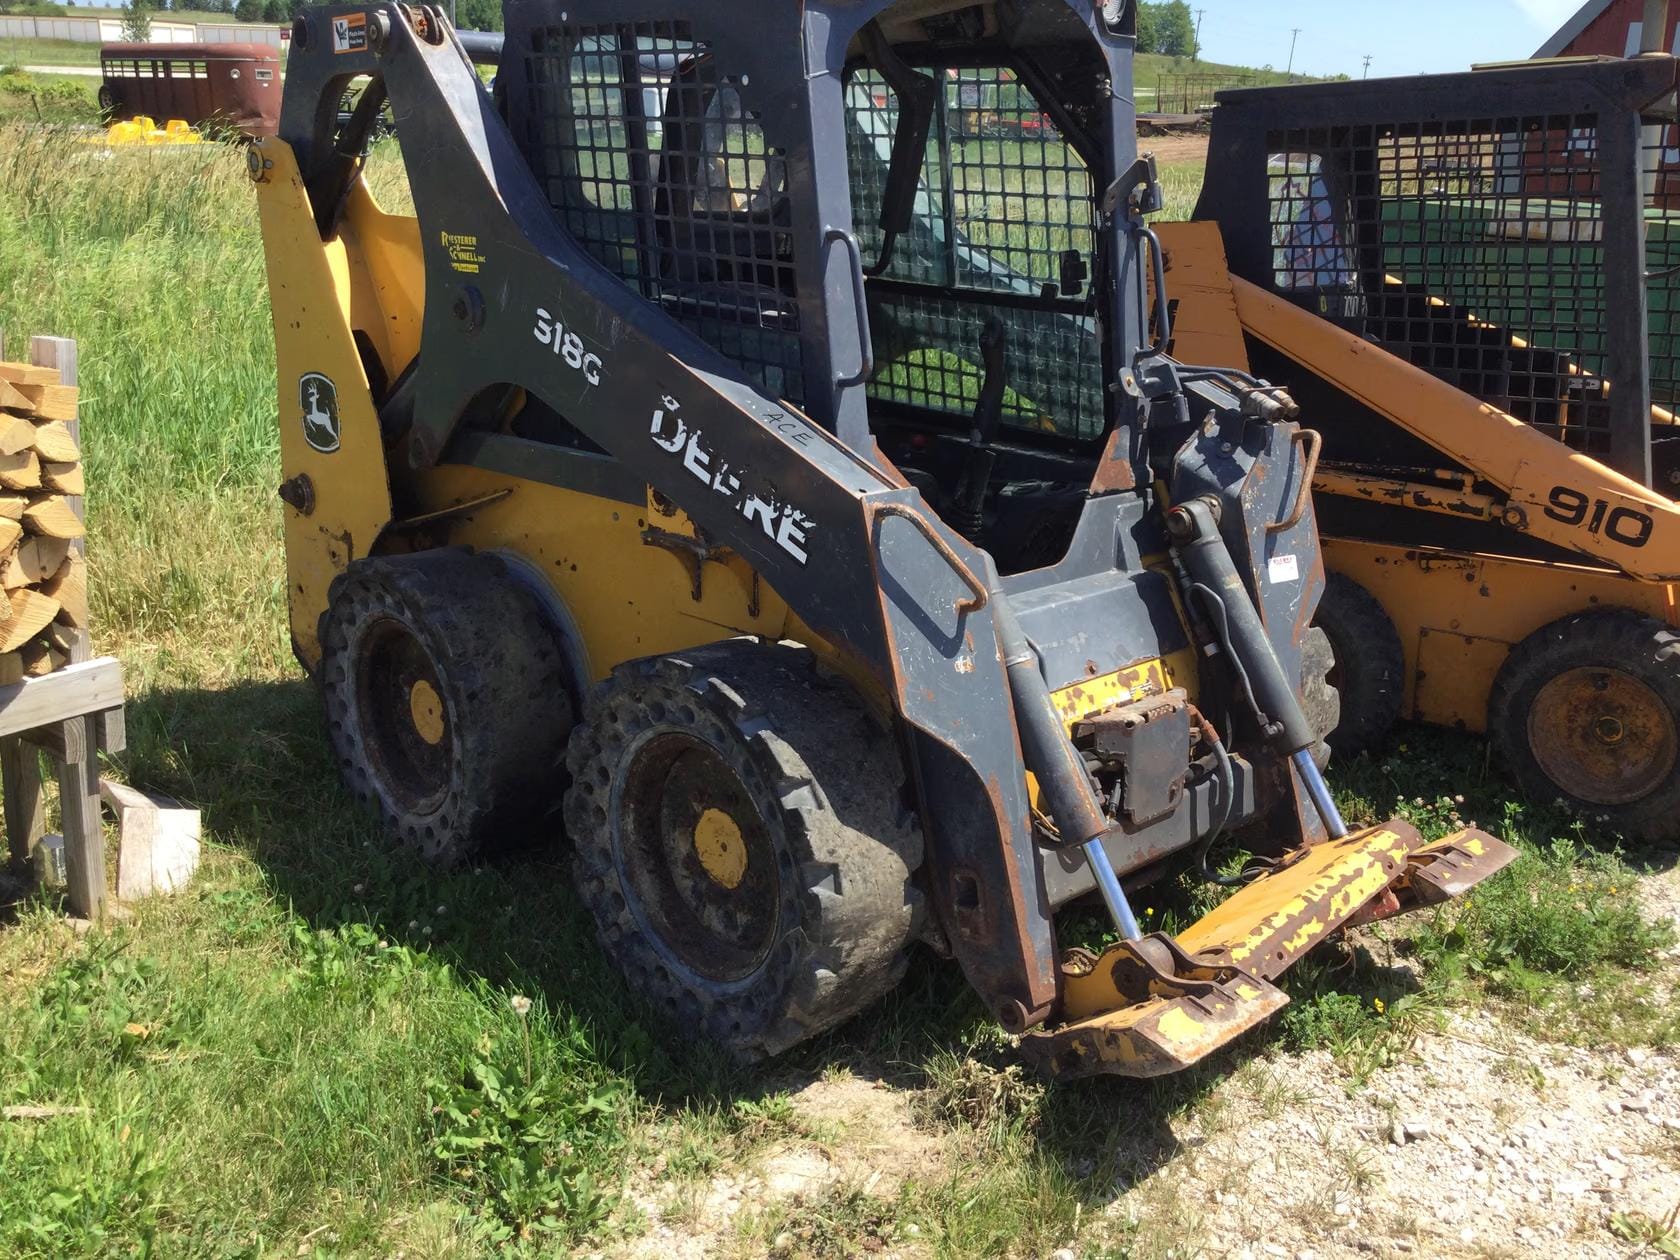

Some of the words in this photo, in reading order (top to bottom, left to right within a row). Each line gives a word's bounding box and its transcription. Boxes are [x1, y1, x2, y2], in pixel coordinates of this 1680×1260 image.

[533, 307, 603, 387] 318G
[762, 413, 814, 447] ACE
[1543, 485, 1654, 549] 910
